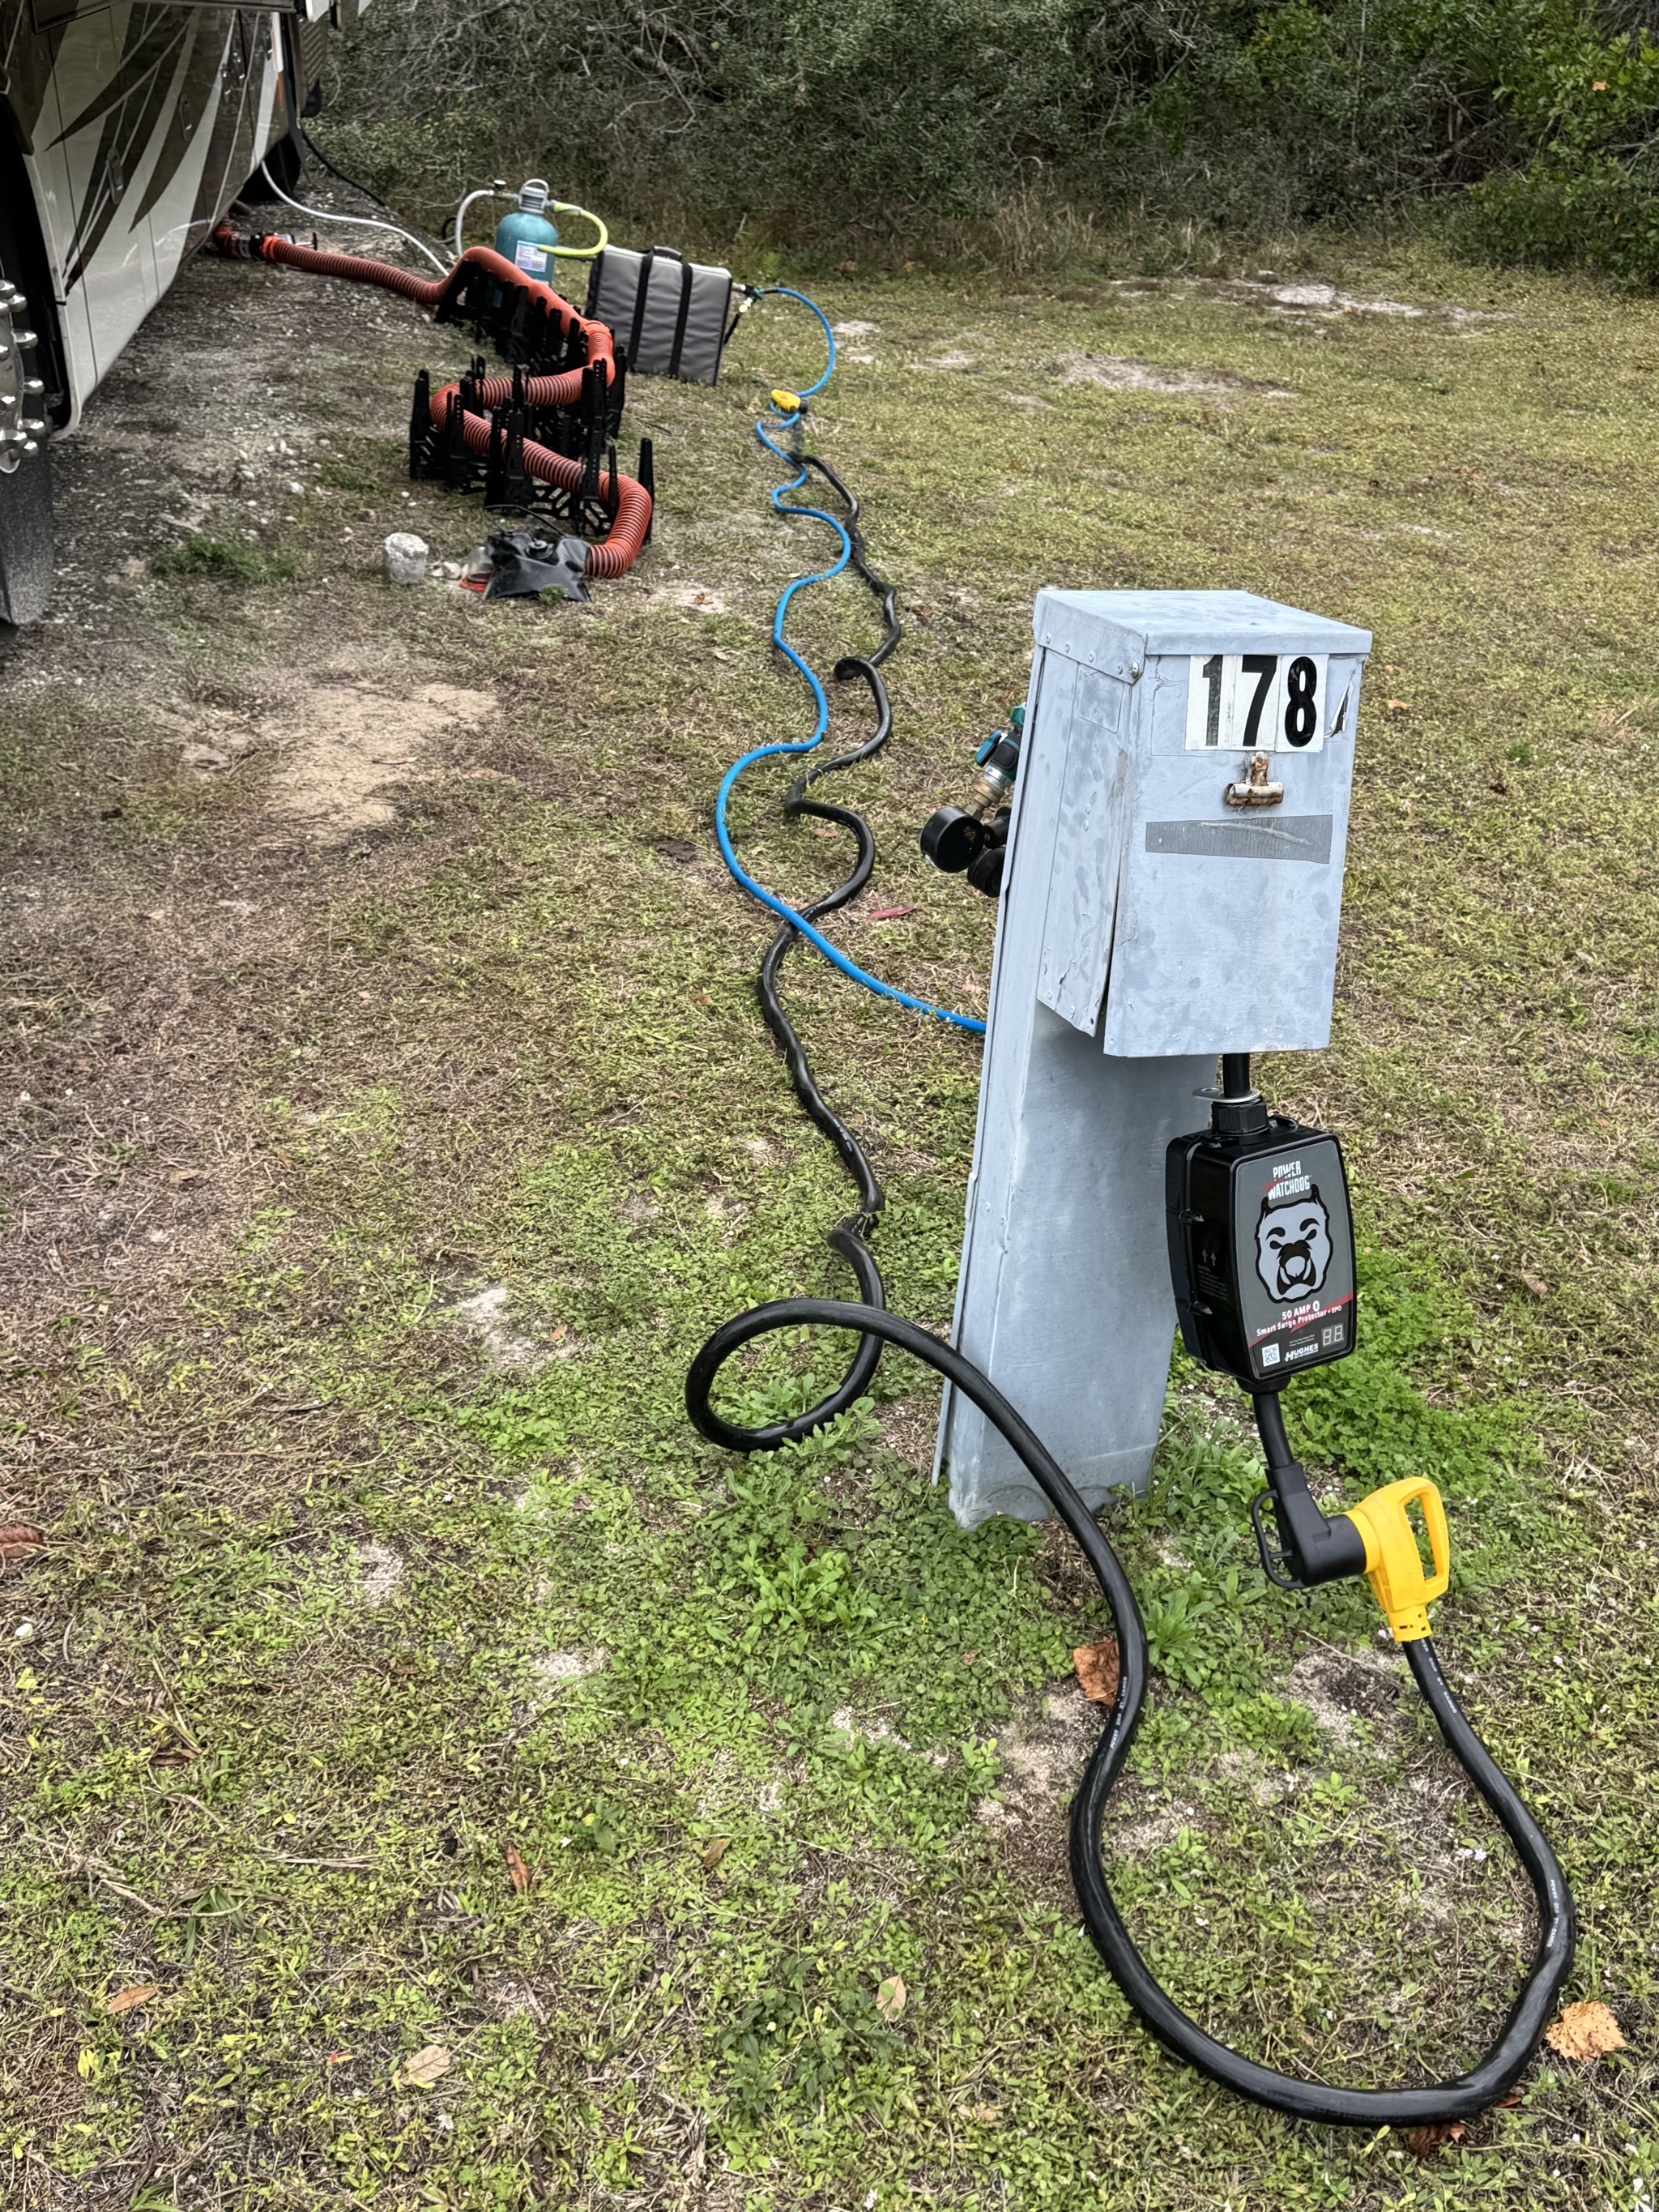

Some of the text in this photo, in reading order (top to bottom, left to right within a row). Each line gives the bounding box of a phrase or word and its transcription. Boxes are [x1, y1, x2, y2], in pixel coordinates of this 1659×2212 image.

[1202, 654, 1318, 748] 178
[1273, 1160, 1301, 1181] POWER
[1268, 1175, 1311, 1200] WATCHDOG
[1256, 1325, 1277, 1337] Smart
[1277, 1319, 1296, 1330] Surge
[1298, 1309, 1327, 1324] Protector
[1282, 1304, 1311, 1320] 50 AMP
[1284, 1343, 1319, 1362] HUGHES
